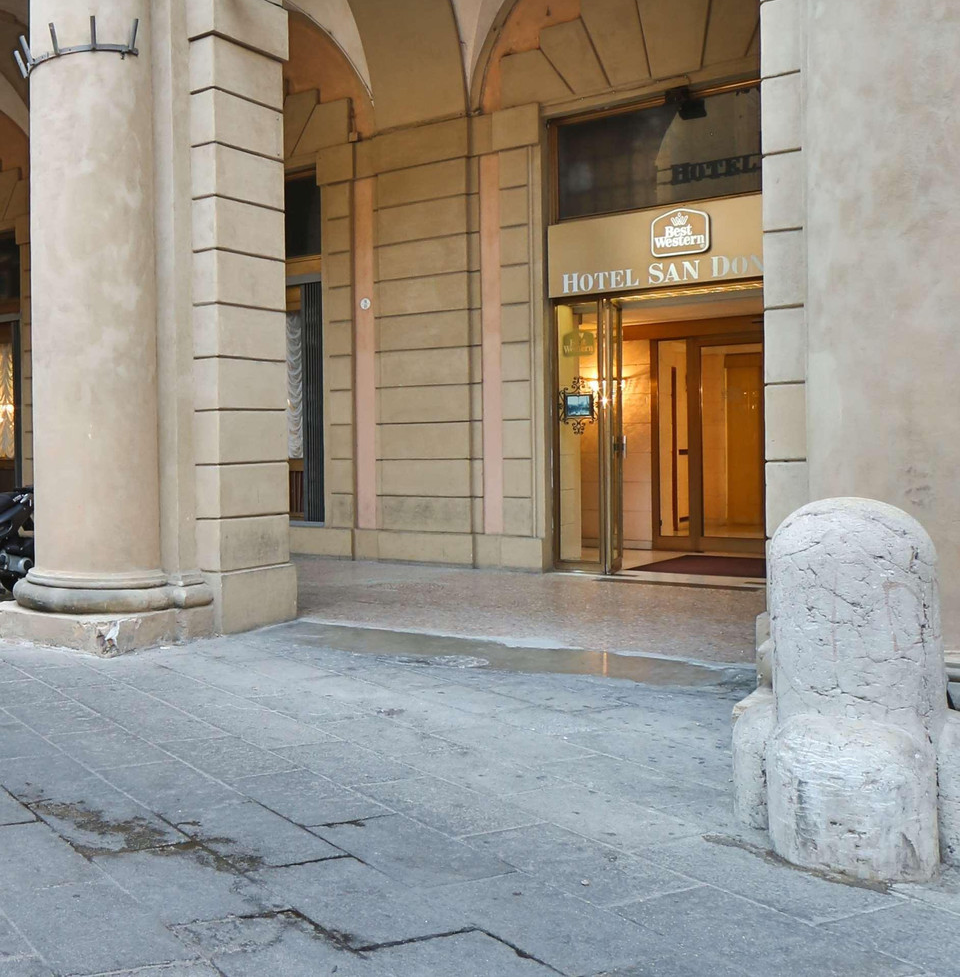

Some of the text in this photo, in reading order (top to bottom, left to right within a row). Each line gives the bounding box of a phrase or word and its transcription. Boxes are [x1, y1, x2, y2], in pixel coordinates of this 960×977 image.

[664, 223, 692, 238] Best
[654, 234, 705, 248] Western
[562, 269, 639, 294] HOTEL
[648, 261, 700, 284] SAN
